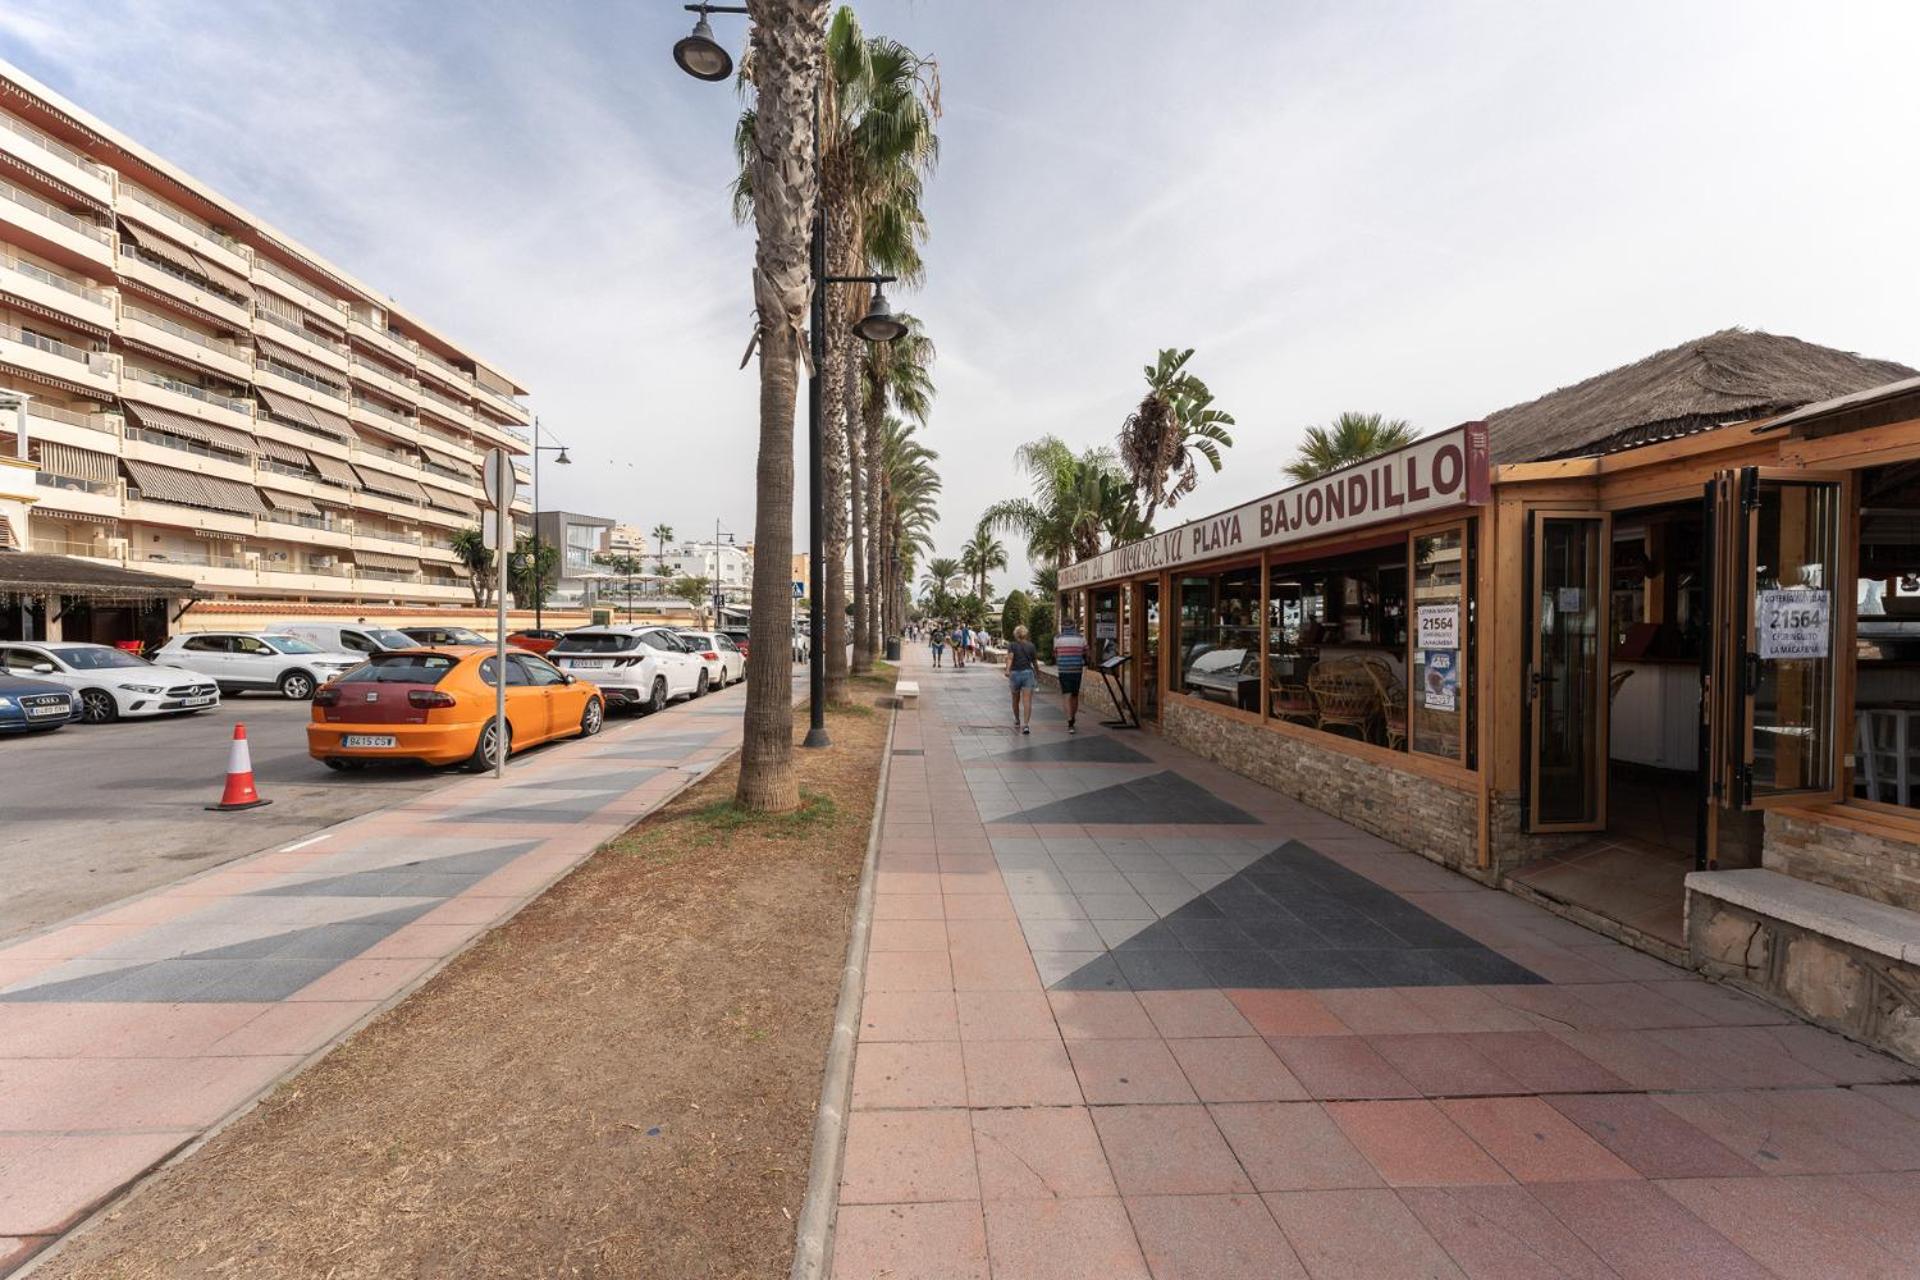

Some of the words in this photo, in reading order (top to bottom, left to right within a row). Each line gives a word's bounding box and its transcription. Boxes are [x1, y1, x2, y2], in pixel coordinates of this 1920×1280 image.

[1109, 529, 1183, 577] MACARENA
[1193, 514, 1242, 554] PLAYA
[1260, 444, 1464, 538] BAJONDILLO
[1423, 617, 1453, 630] 21564
[1770, 609, 1821, 629] 21564
